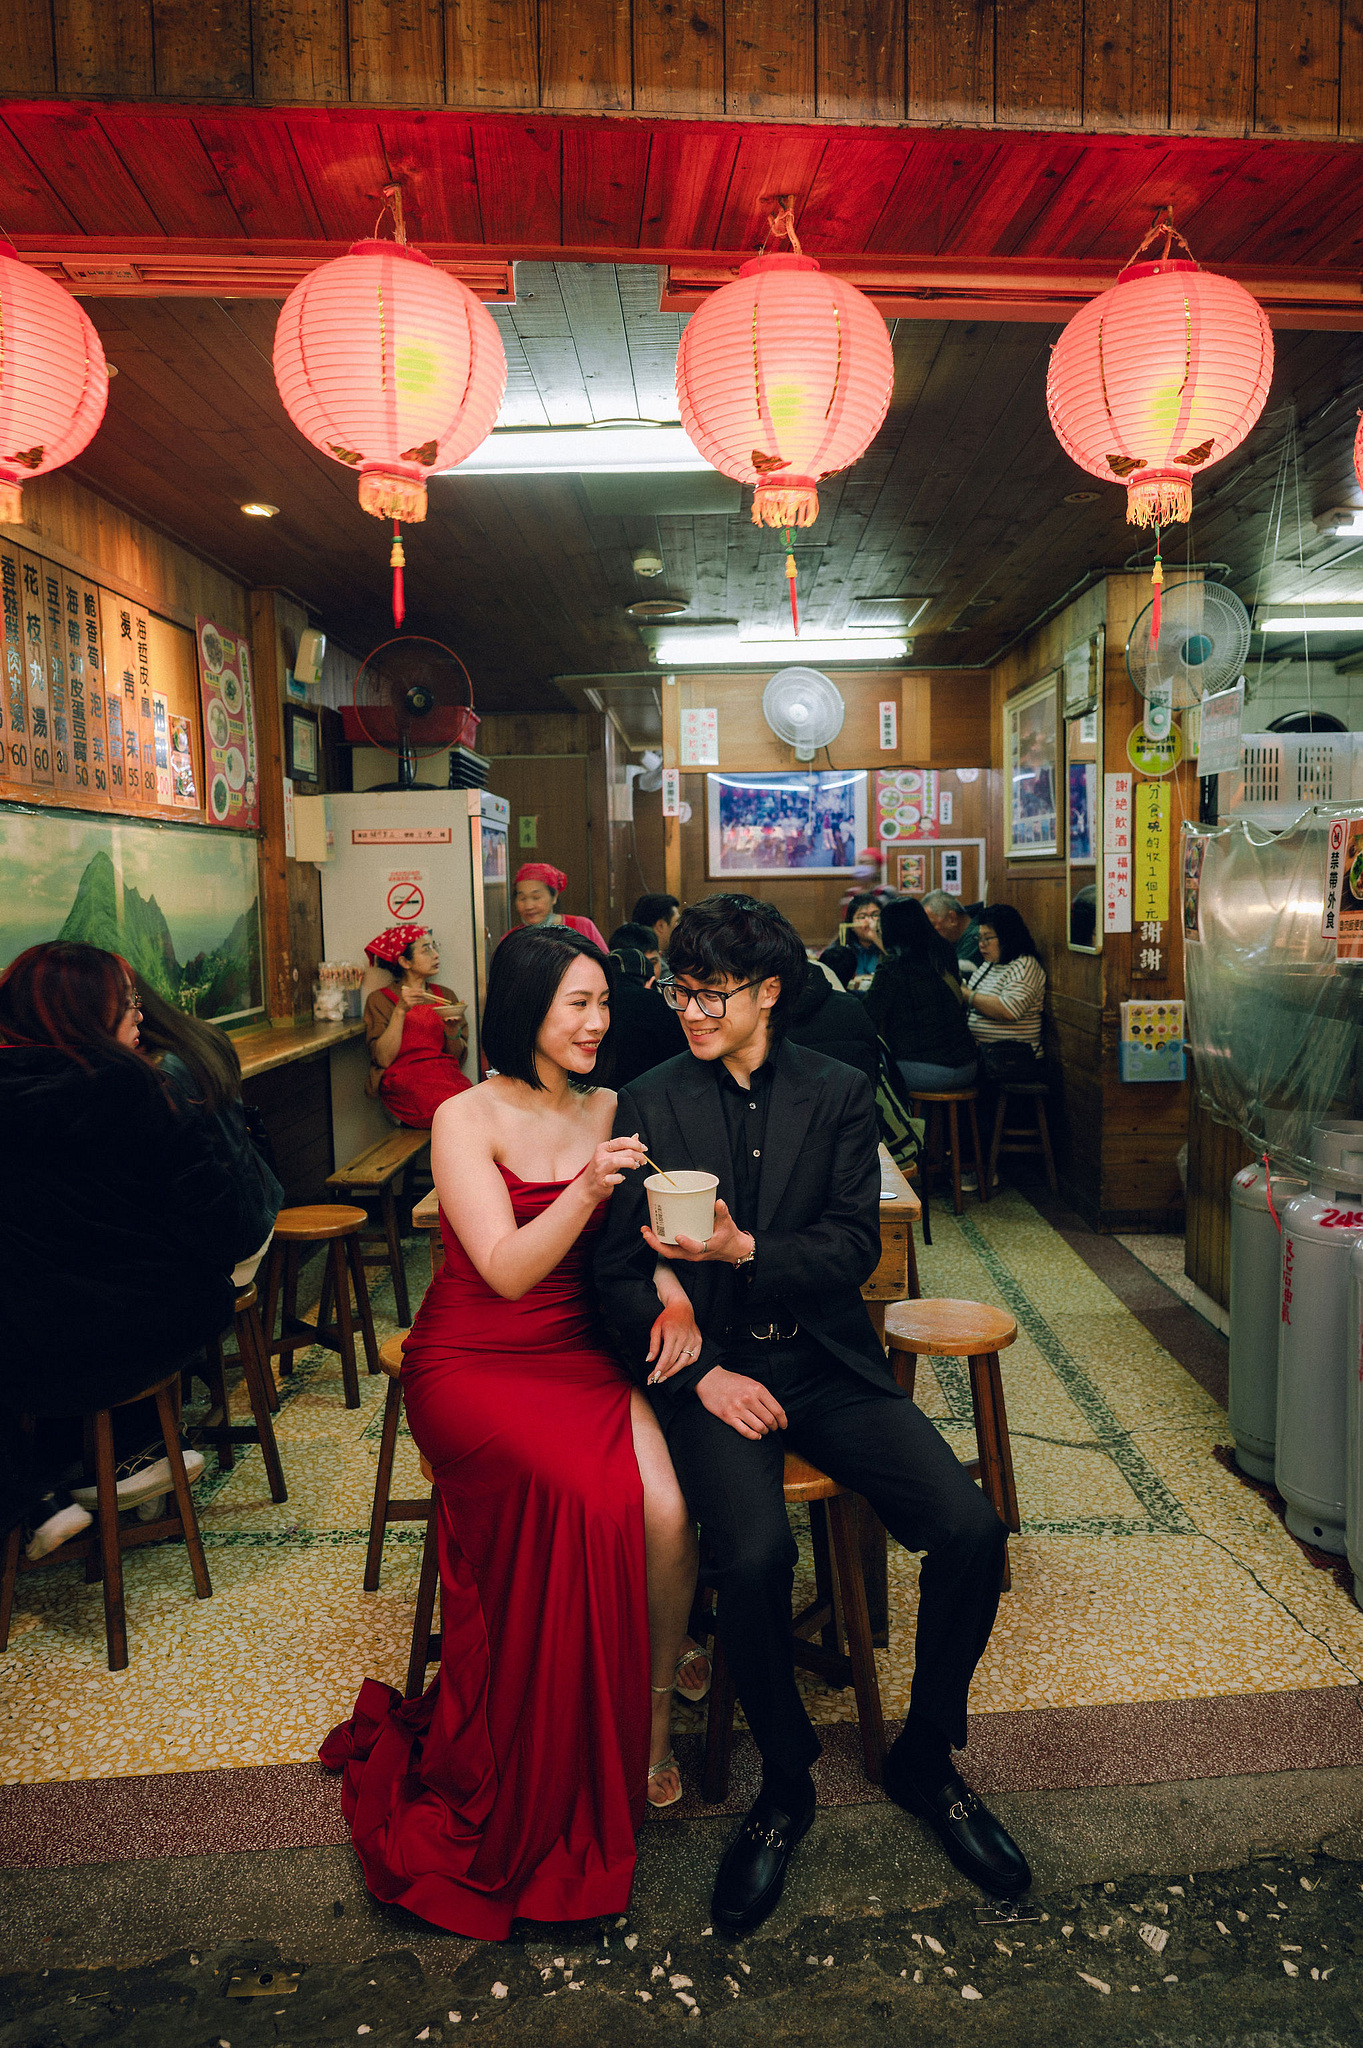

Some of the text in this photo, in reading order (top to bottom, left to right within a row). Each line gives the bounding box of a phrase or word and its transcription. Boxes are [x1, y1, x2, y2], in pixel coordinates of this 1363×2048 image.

[23, 563, 49, 770] 花枝丸湯 60
[66, 585, 88, 787] 海帶 30 皮蛋豆腐 50
[1136, 735, 1176, 743] 本用
[12, 743, 27, 767] 60
[56, 750, 68, 774] 30
[95, 768, 106, 791] 50
[112, 765, 122, 786] 50
[128, 767, 139, 787] 55
[144, 771, 155, 789] 80
[1115, 780, 1128, 847] 謝絕飲酒
[1117, 857, 1128, 898] 福州丸
[1325, 851, 1340, 929] 禁帶外食
[1139, 921, 1163, 971] 謝謝
